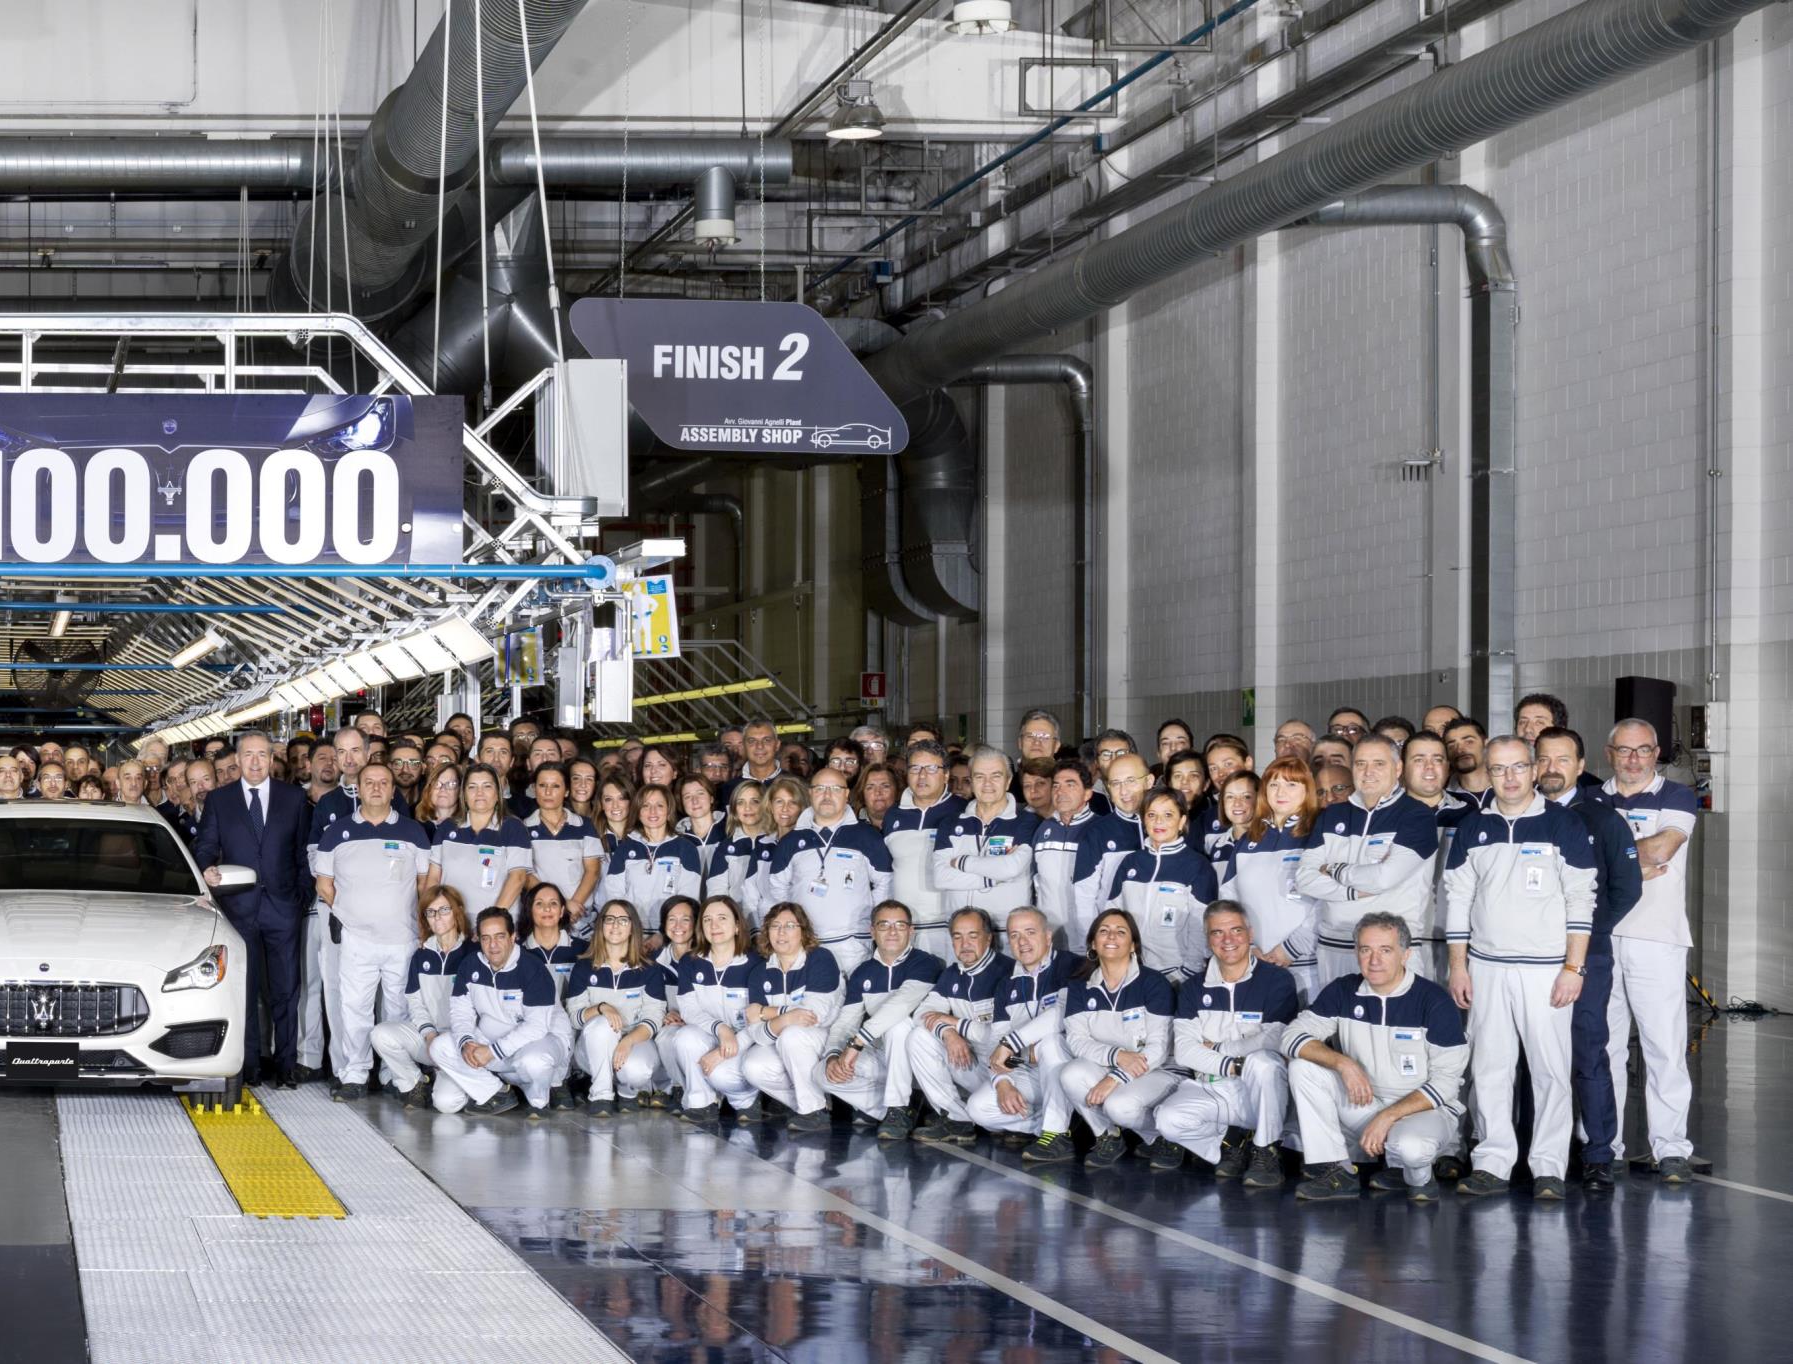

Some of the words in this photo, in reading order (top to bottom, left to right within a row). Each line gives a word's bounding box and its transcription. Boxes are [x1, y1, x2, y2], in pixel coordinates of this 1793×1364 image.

[653, 344, 764, 380] FINISH
[772, 332, 810, 381] 2
[737, 417, 763, 426] Giovanni
[764, 418, 784, 427] Agnelli
[785, 418, 802, 426] Plant
[680, 427, 758, 443] ASSEMBLY
[761, 428, 803, 444] SHOP
[11, 1057, 75, 1067] Quattroporte
